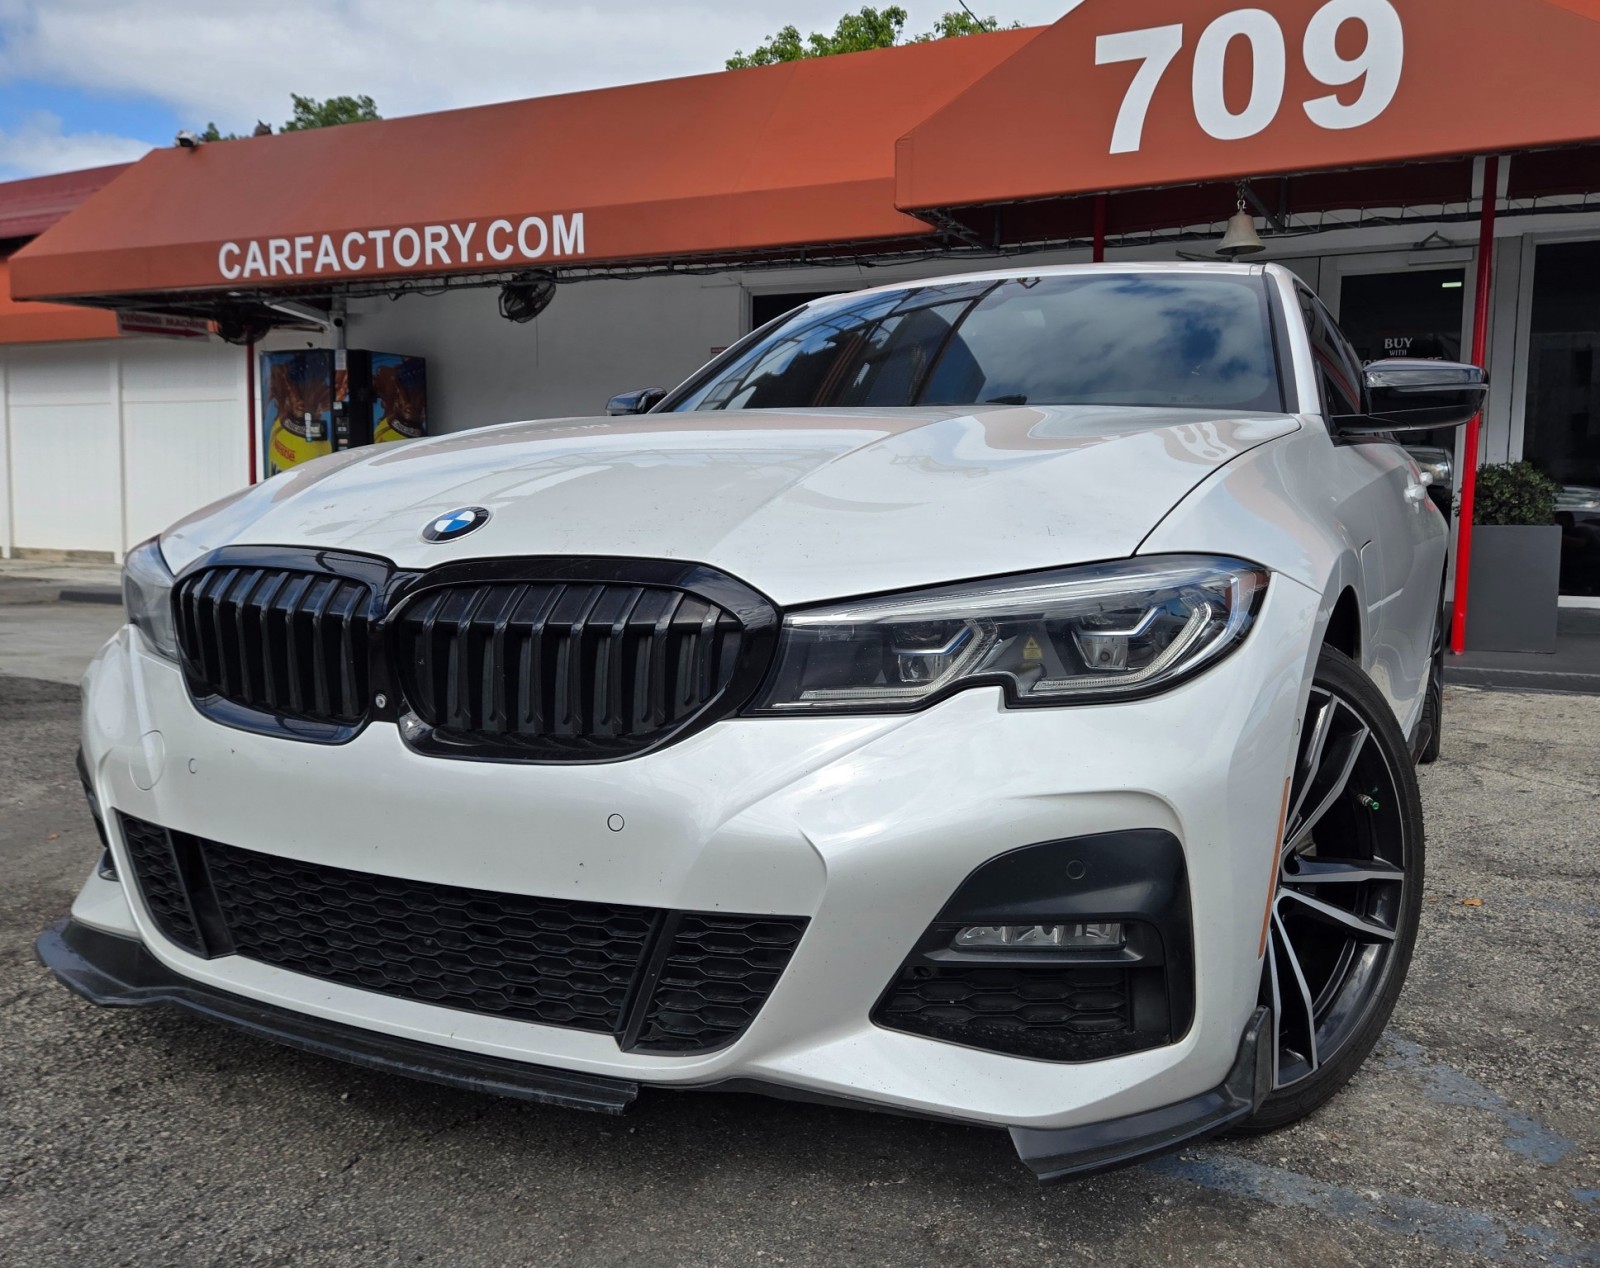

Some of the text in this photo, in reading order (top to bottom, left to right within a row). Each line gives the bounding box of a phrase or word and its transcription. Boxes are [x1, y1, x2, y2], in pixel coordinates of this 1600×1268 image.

[1095, 0, 1404, 155] 709
[218, 212, 586, 280] CARFACTORY.COM
[1384, 337, 1413, 349] BUY
